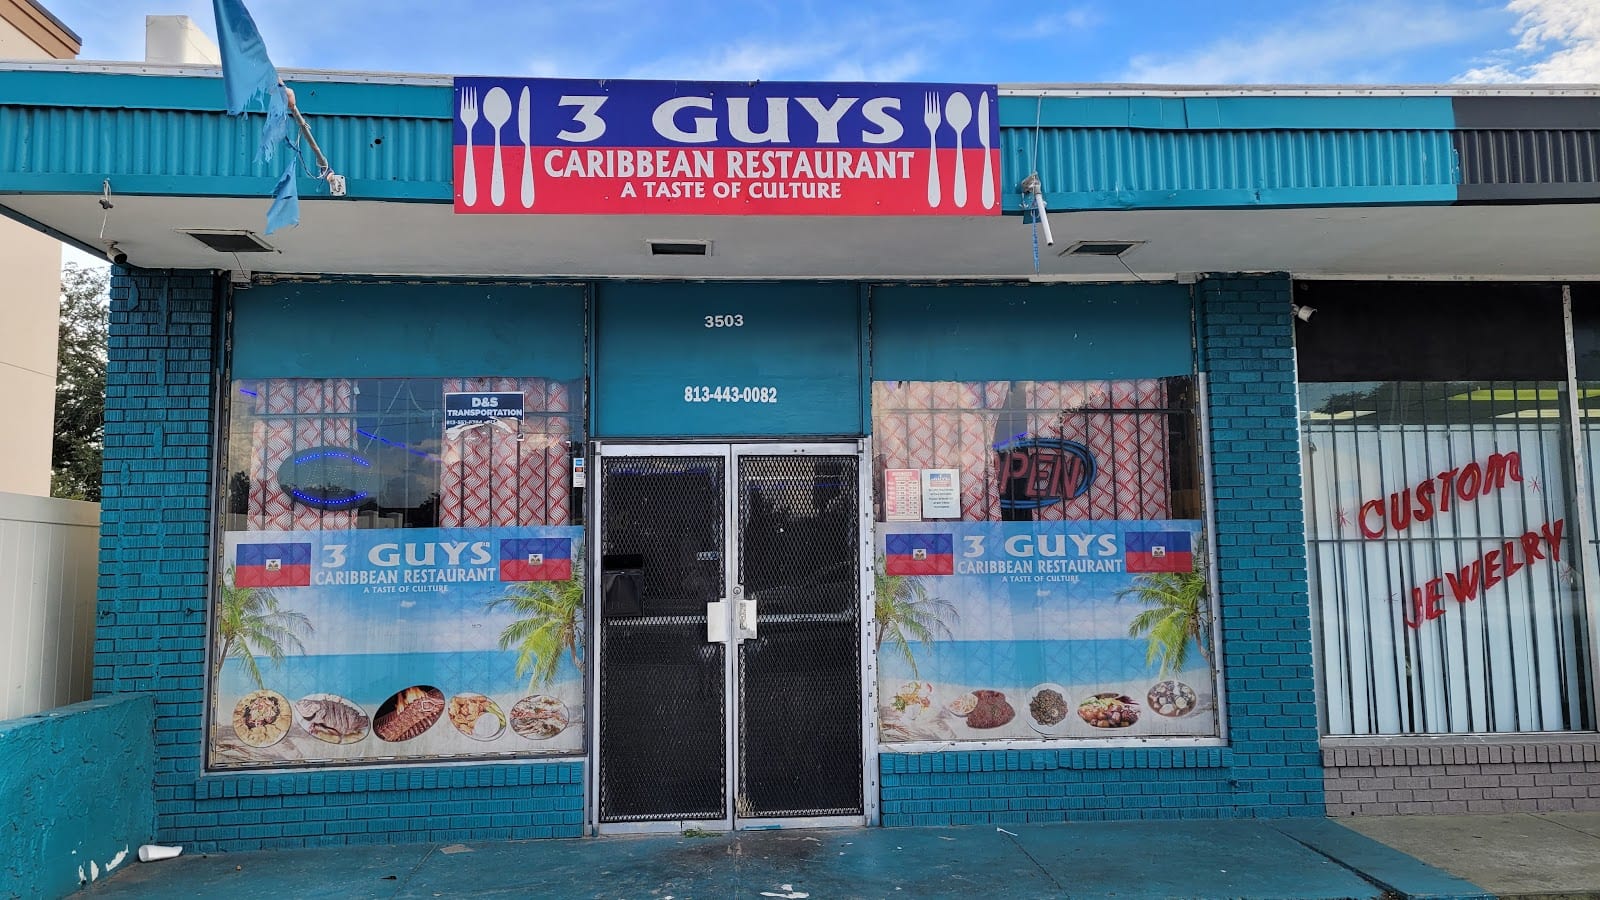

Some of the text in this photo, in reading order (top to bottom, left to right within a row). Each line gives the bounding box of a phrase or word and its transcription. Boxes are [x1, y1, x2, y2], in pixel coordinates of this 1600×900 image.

[556, 95, 905, 144] 3 GUYS
[544, 150, 915, 179] CARIBBEAN RESTAURANT
[620, 182, 843, 200] A TASTE OF CULTURE
[704, 314, 744, 328] 3503
[471, 397, 499, 408] D&S
[684, 386, 778, 403] 813-443-0082
[447, 409, 523, 417] TRANSPORTATION
[1358, 451, 1524, 539] CUSTOM
[321, 541, 492, 568] 3 GUYS
[963, 533, 1118, 558] 3 GUYS
[957, 559, 1123, 575] CARIBBEAN RESTAURANT
[1404, 519, 1564, 630] JEWELRY
[315, 567, 497, 586] CARIBBEAN RESTAURANT
[1047, 575, 1080, 583] CULTURE
[399, 585, 409, 593] OF
[412, 584, 449, 593] CULTURE
